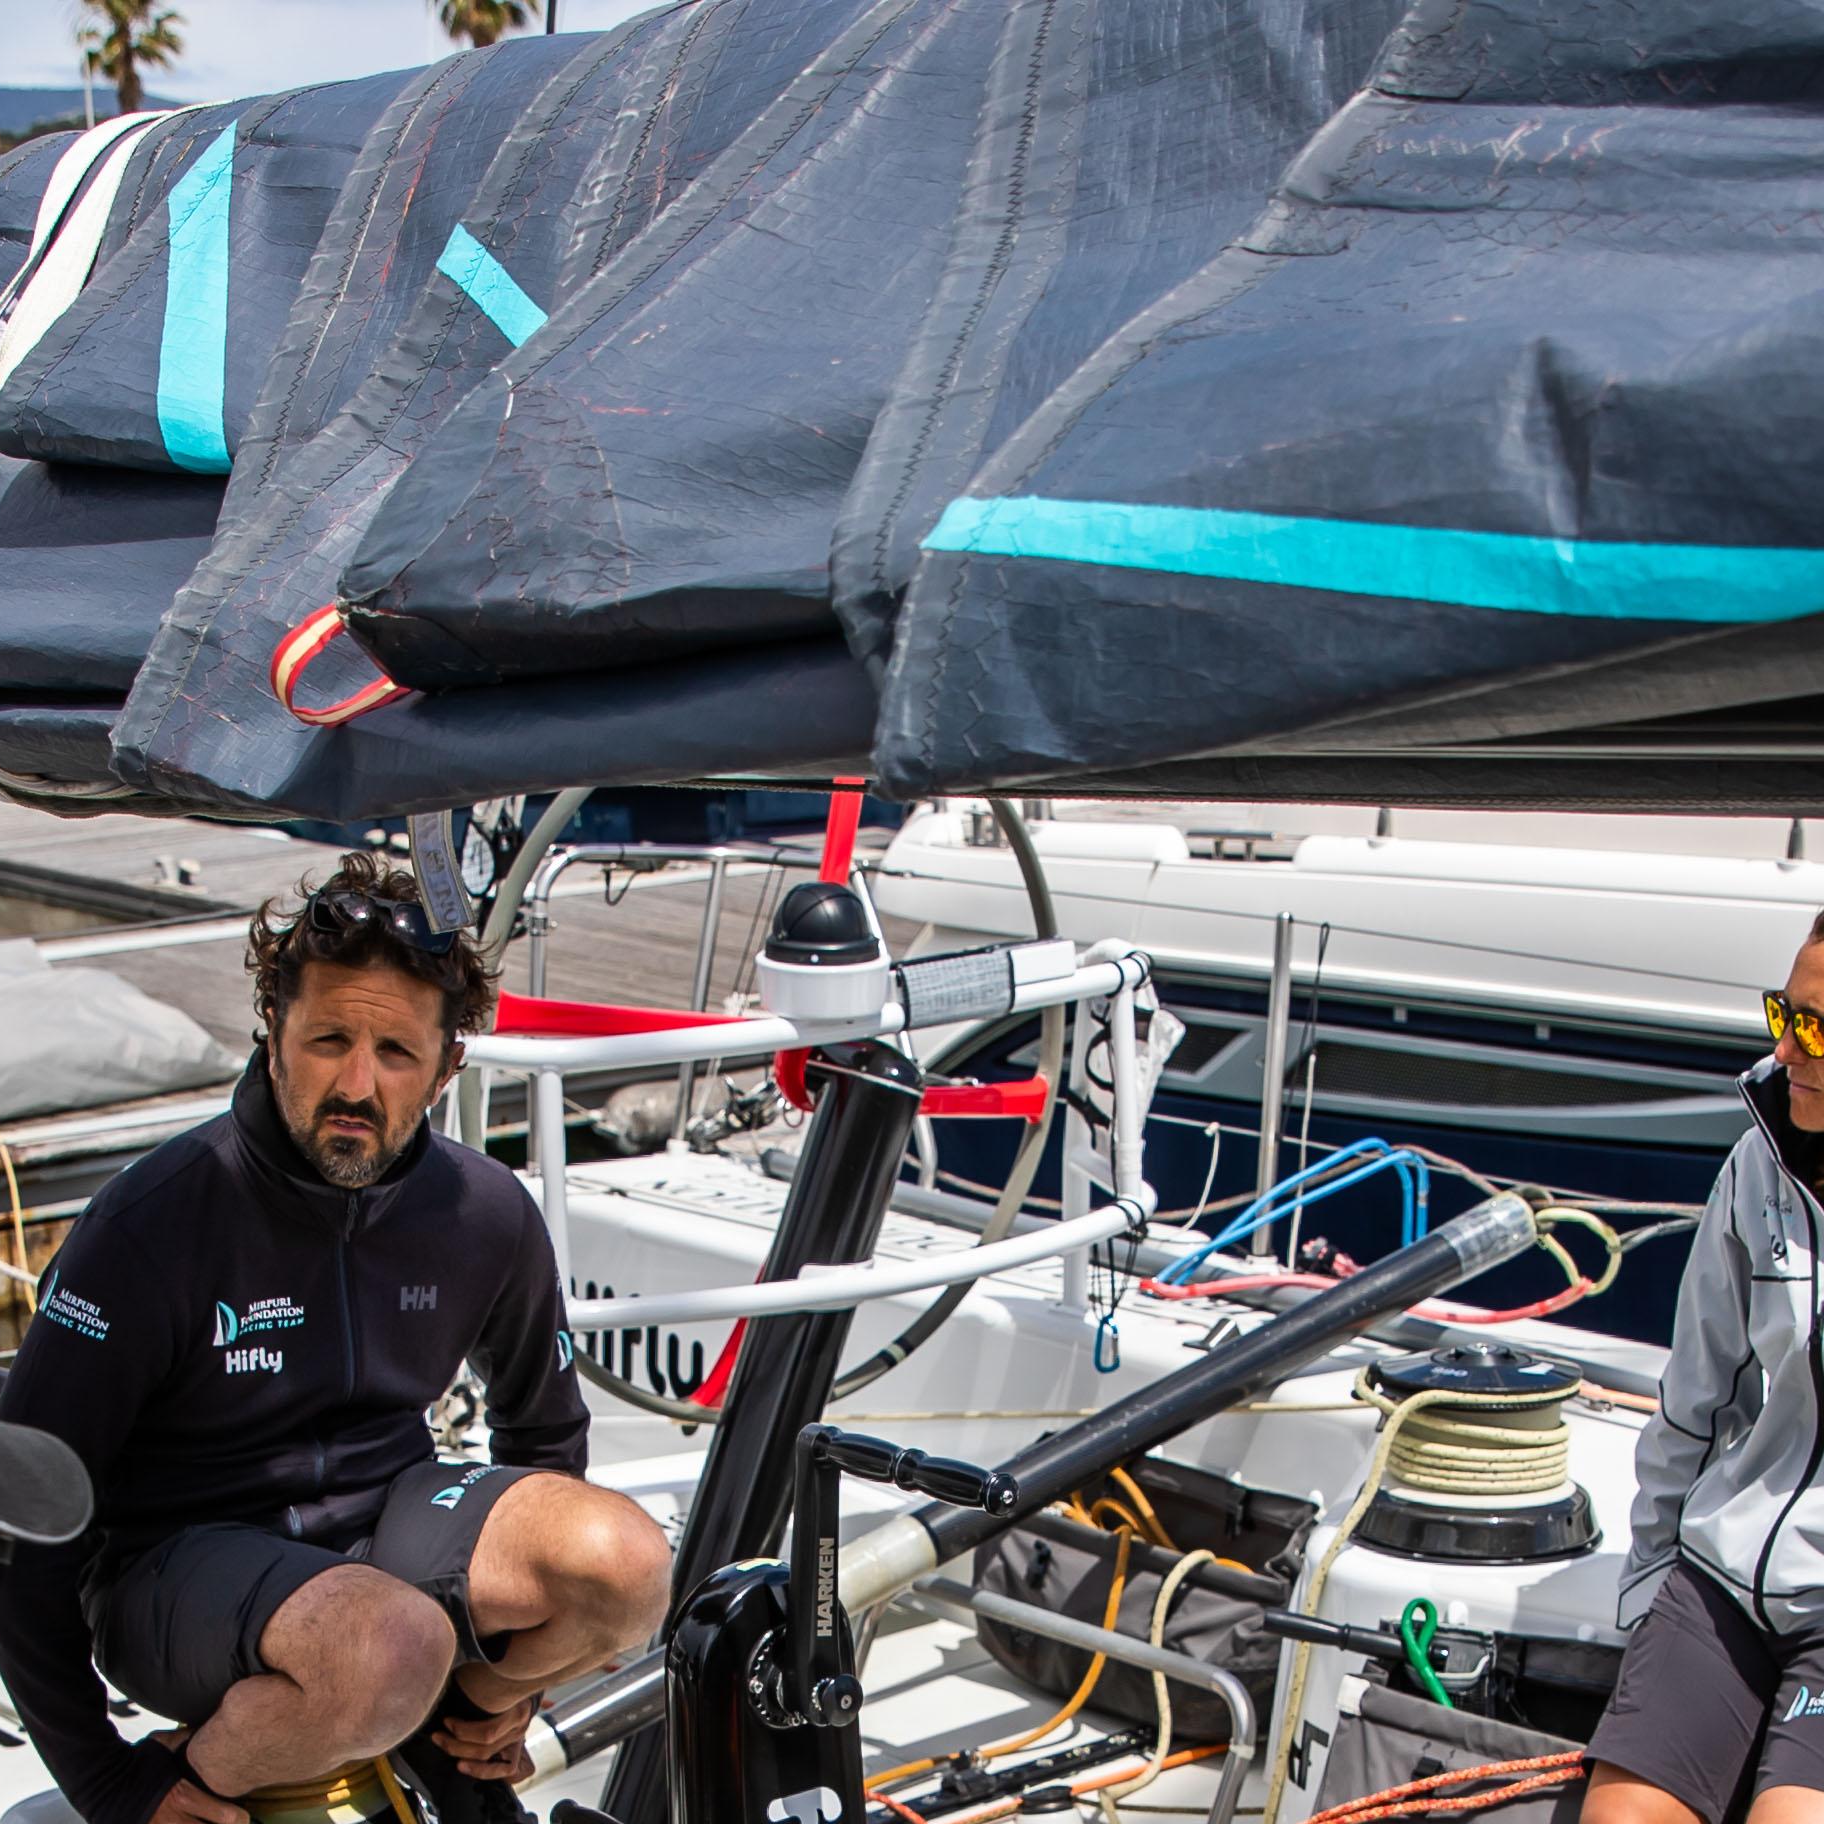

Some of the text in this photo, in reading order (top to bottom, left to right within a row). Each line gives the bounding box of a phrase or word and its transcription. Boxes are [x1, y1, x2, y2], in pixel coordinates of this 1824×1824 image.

[58, 1288, 101, 1316] MIRPURI
[248, 1296, 291, 1314] MIRPURI
[399, 1285, 438, 1311] HH
[48, 1296, 110, 1332] FOUNDATION
[240, 1306, 304, 1329] FOUNDATION
[277, 1317, 305, 1330] TEAM
[76, 1323, 106, 1342] TEAM
[225, 1347, 283, 1375] Hifly
